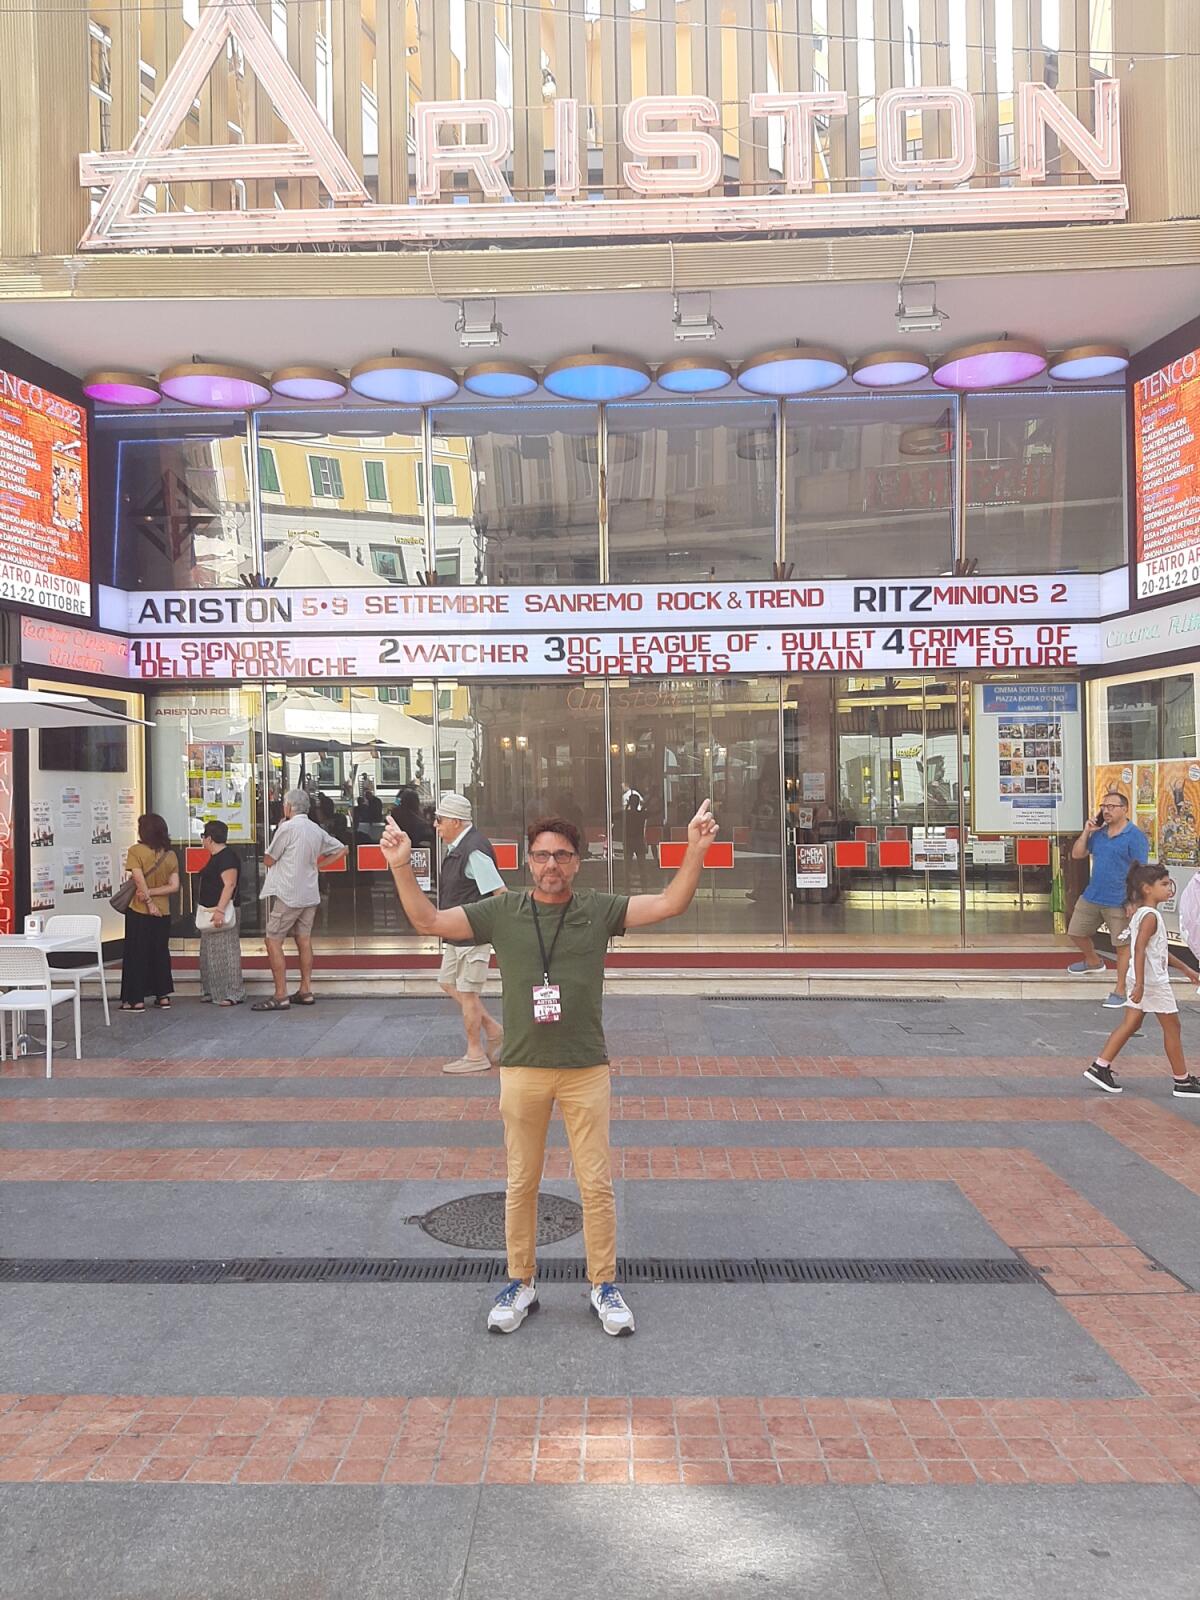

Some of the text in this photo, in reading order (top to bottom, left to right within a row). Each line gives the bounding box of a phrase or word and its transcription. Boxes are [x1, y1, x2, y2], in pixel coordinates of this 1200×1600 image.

[77, 0, 1127, 250] ARISTON
[1140, 353, 1197, 400] TENCO
[45, 398, 81, 428] 2022
[1146, 552, 1185, 576] TEATRO
[2, 564, 80, 595] ATRO ARISTON
[39, 591, 86, 614] OTTOBRE
[138, 597, 293, 624] ARISTON
[365, 594, 509, 614] SETTEMBRE
[525, 592, 643, 612] SANREMO
[657, 591, 722, 611] ROCK
[726, 591, 742, 609] &
[746, 588, 824, 609] TREND
[853, 583, 1068, 612] RITZ MINIONS 2
[379, 638, 528, 664] 2 WATCHER
[544, 633, 759, 662] 3 DC LEAGUE OF
[781, 630, 876, 651] BULLET
[882, 626, 1071, 655] 4 CRIMES OF
[131, 641, 291, 666] 1 IL SIGNORE
[567, 654, 731, 675] SUPER PETS
[782, 650, 863, 671] TRAIN
[908, 646, 1078, 667] THE FUTURE
[141, 657, 357, 678] DELLE FORMICHE
[155, 708, 207, 716] ARISTON
